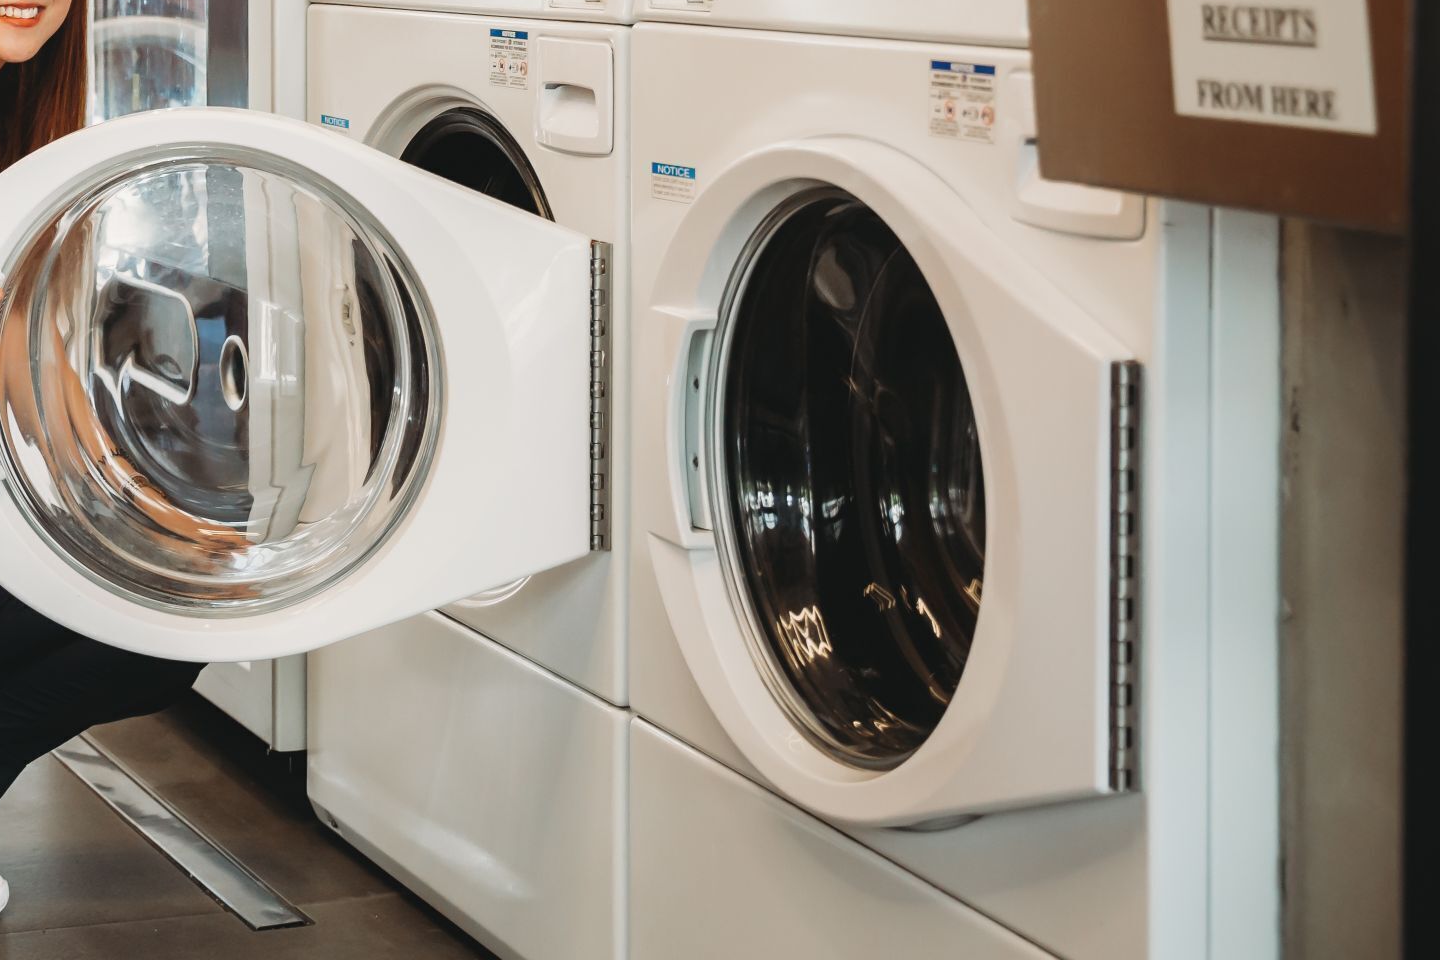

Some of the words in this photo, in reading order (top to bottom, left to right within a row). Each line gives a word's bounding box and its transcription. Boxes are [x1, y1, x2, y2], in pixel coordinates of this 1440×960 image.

[1201, 4, 1317, 41] RECEIPTS
[1196, 79, 1262, 112] FROM
[1271, 87, 1337, 121] HERE
[325, 116, 346, 128] NOTICE
[657, 164, 690, 178] NOTICE
